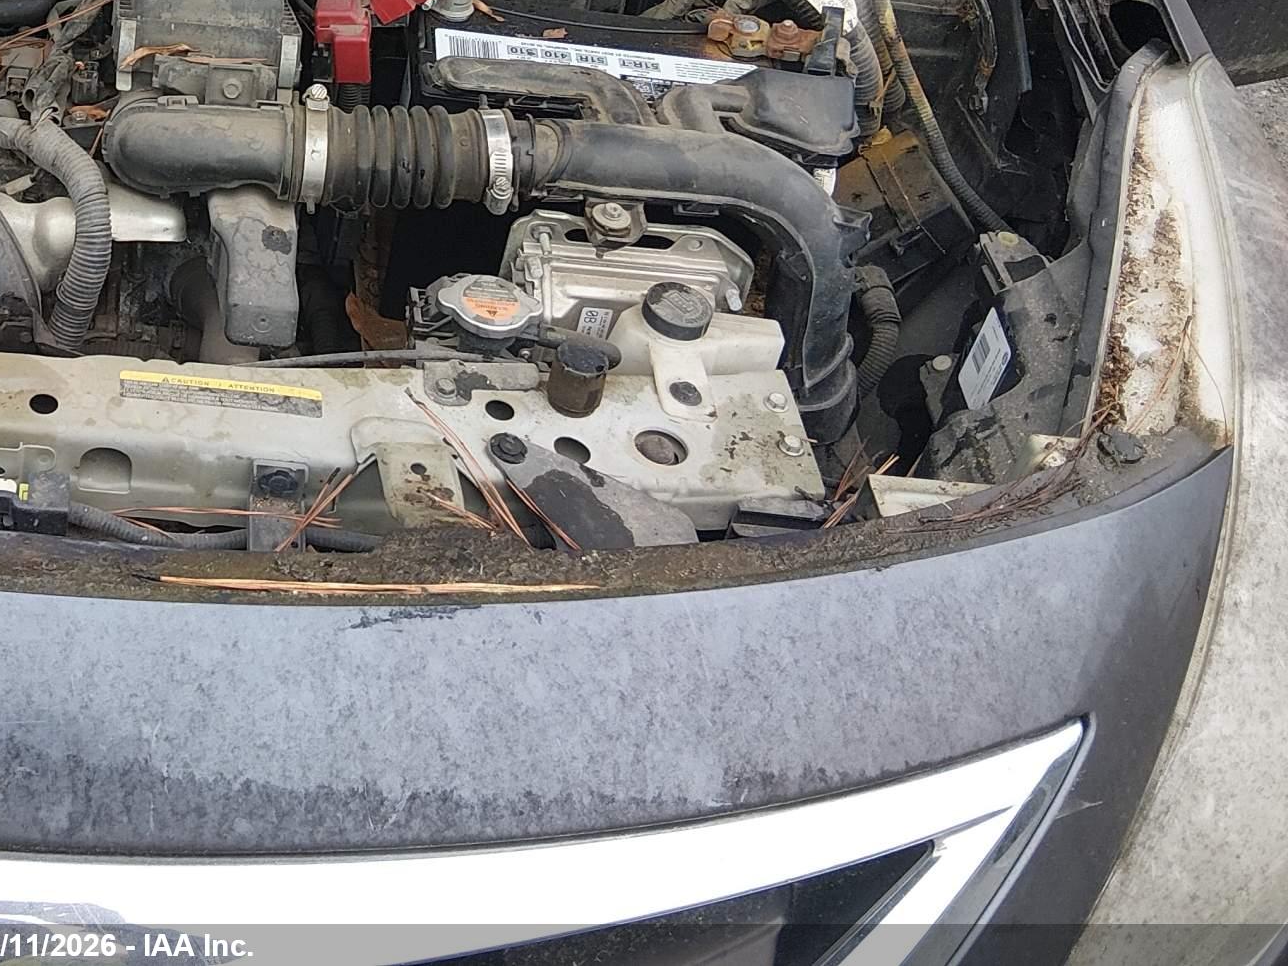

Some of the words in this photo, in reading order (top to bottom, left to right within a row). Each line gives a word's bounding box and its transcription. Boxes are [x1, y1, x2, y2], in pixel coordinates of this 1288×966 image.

[544, 50, 568, 59] 410
[579, 55, 605, 64] 51R
[620, 59, 659, 70] 51R-T
[170, 377, 210, 387] CAUTION
[227, 383, 275, 393] ATTENTION
